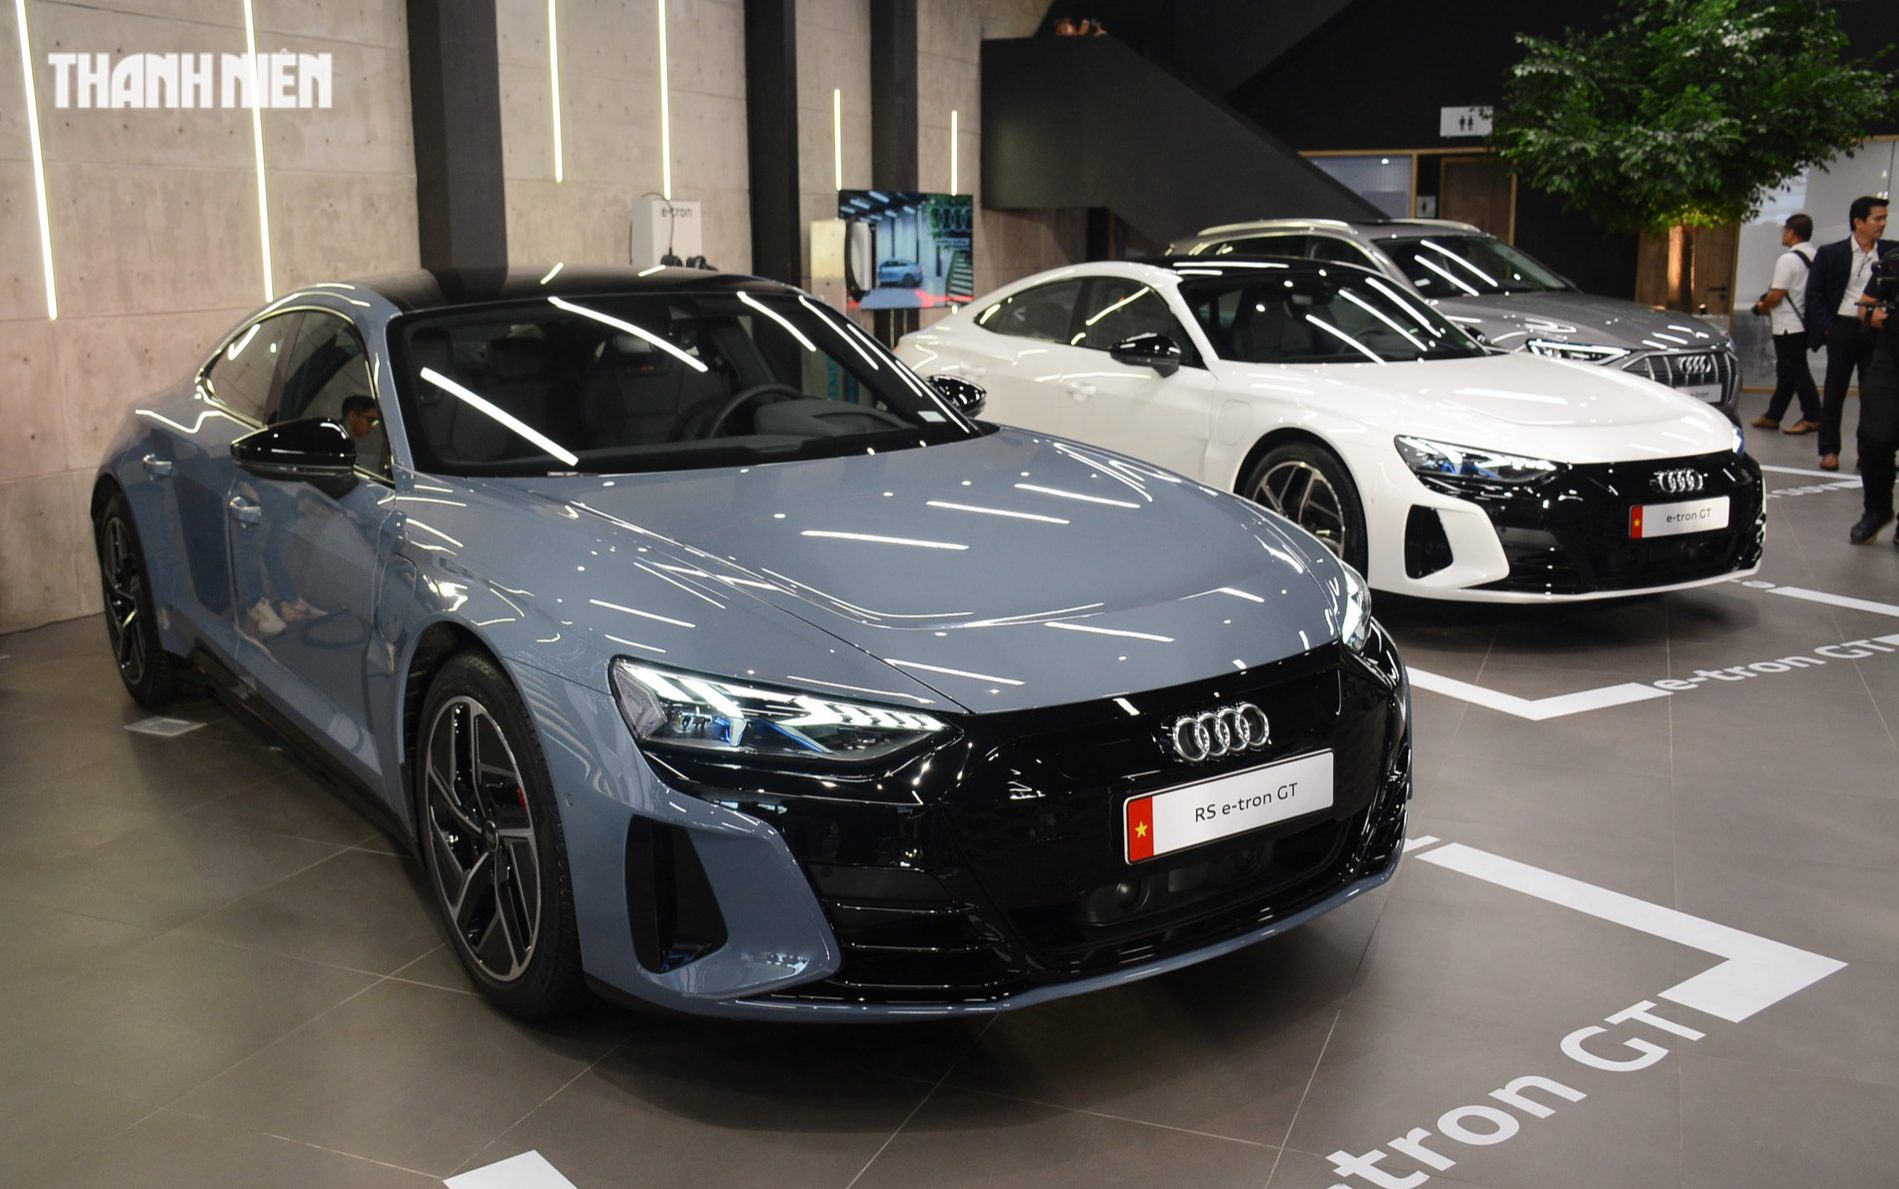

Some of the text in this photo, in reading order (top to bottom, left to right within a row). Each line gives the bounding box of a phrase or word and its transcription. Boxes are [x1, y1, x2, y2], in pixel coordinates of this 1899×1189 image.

[1666, 508, 1711, 523] e-tron GT
[1653, 639, 1896, 690] e-tron GT
[1195, 782, 1298, 822] RS e-tron GT
[1326, 1000, 1707, 1189] tron GT
